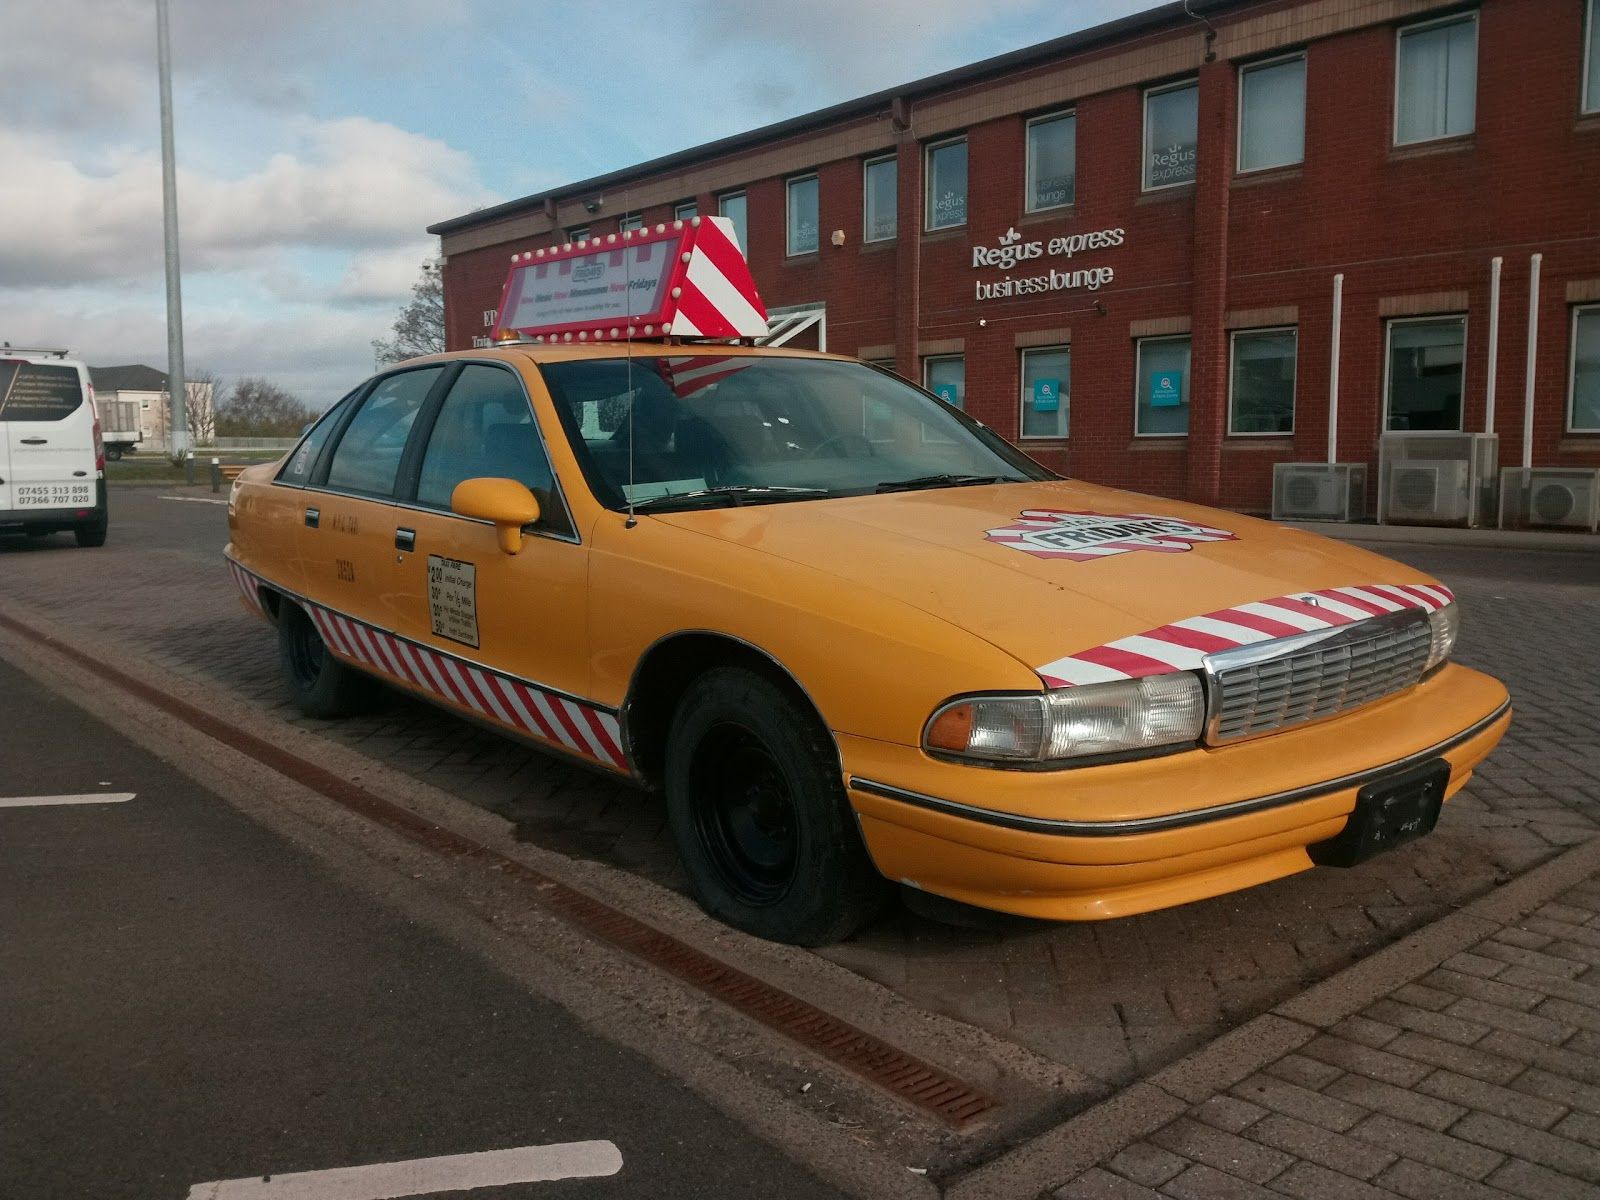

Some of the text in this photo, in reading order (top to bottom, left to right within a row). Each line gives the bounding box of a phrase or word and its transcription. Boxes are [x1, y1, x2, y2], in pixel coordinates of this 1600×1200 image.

[1152, 150, 1195, 168] Regus
[1151, 163, 1195, 182] express
[1036, 189, 1066, 203] ounge
[972, 228, 1125, 270] Regus express
[628, 278, 657, 291] Fridays
[18, 486, 89, 495] 07455 313 898
[19, 495, 89, 505] 07366 707 020
